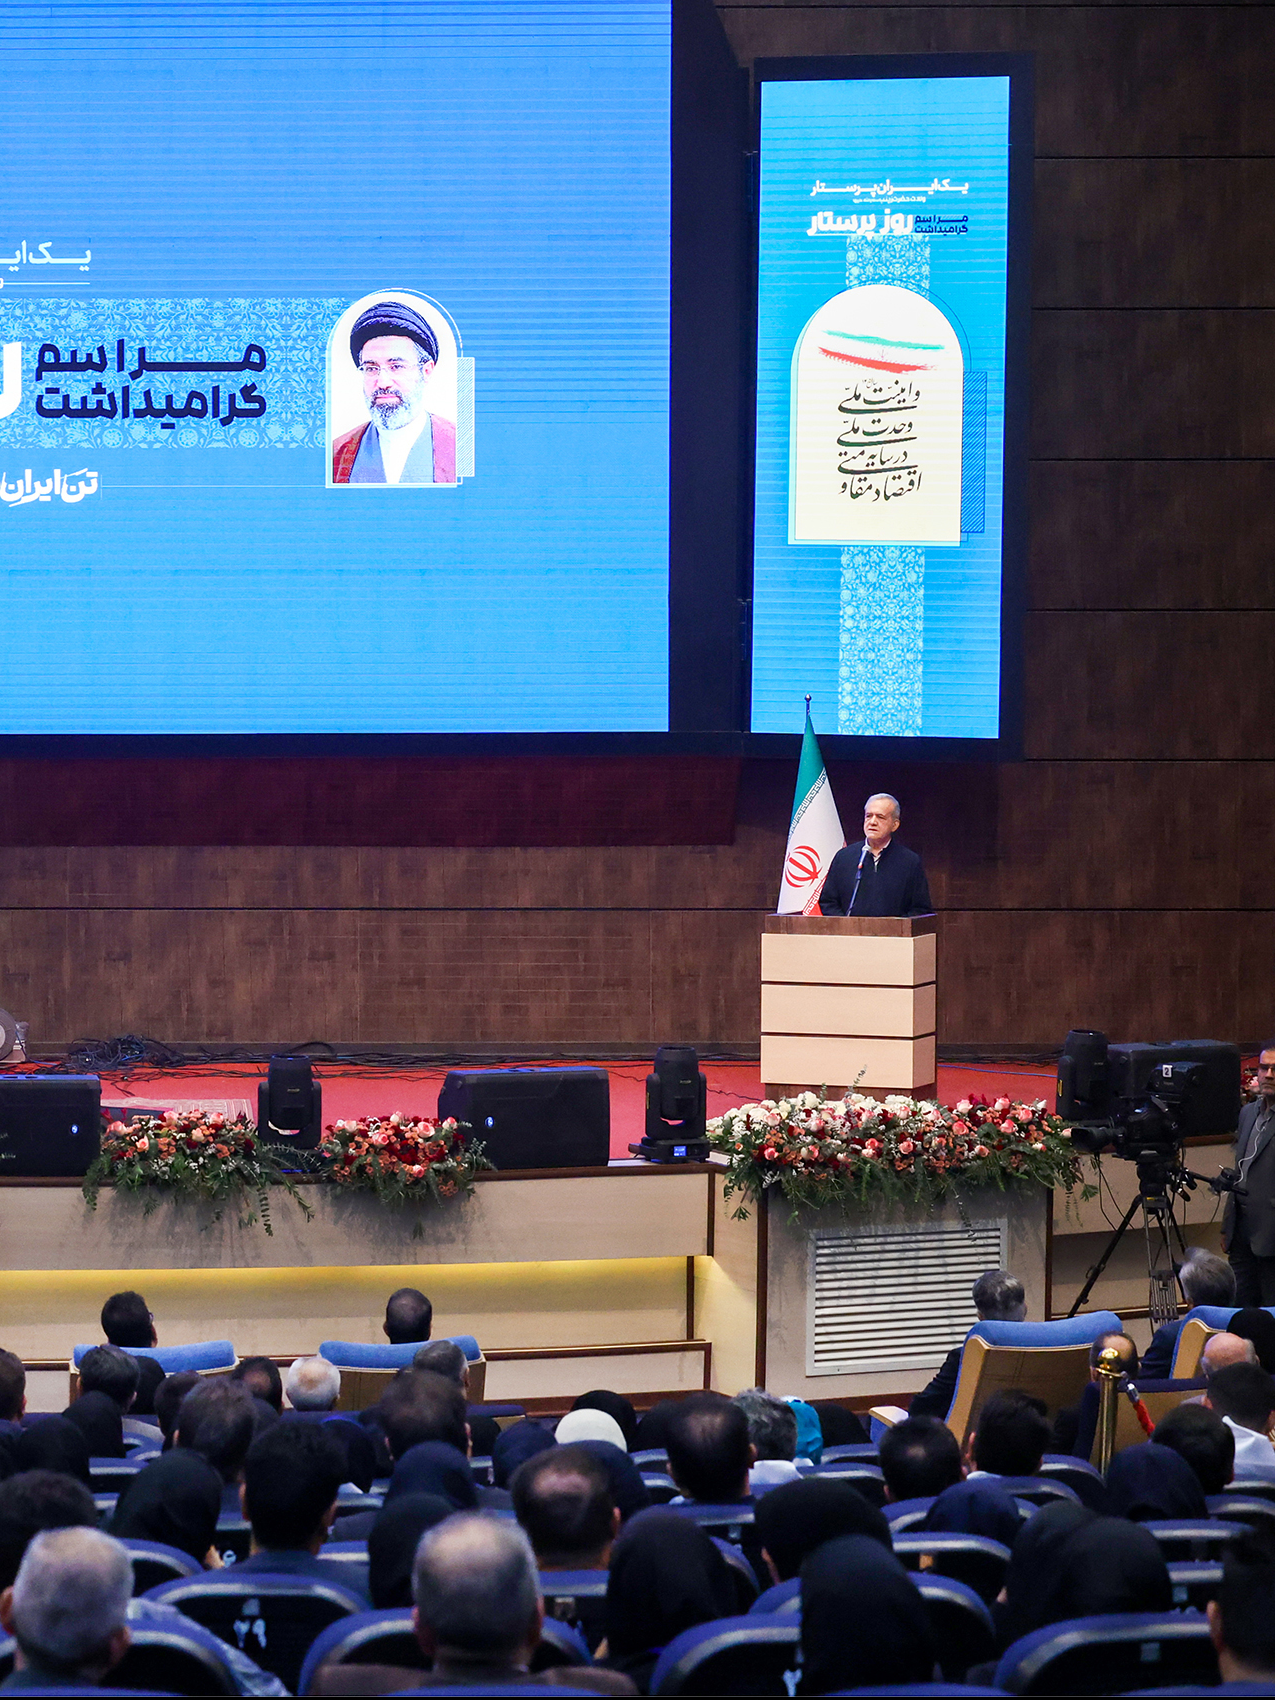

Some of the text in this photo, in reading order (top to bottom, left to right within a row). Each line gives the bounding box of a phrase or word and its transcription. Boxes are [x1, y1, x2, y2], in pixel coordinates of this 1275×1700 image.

[810, 178, 969, 198] یک ایران پرستار
[806, 208, 914, 240] روز پرستار
[915, 215, 969, 225] مراسم
[28, 241, 92, 272] یک
[35, 338, 267, 382] مراسم
[35, 382, 267, 430] گرامیداشت
[0, 468, 61, 507] ایران
[232, 1618, 267, 1649] ۲۹
